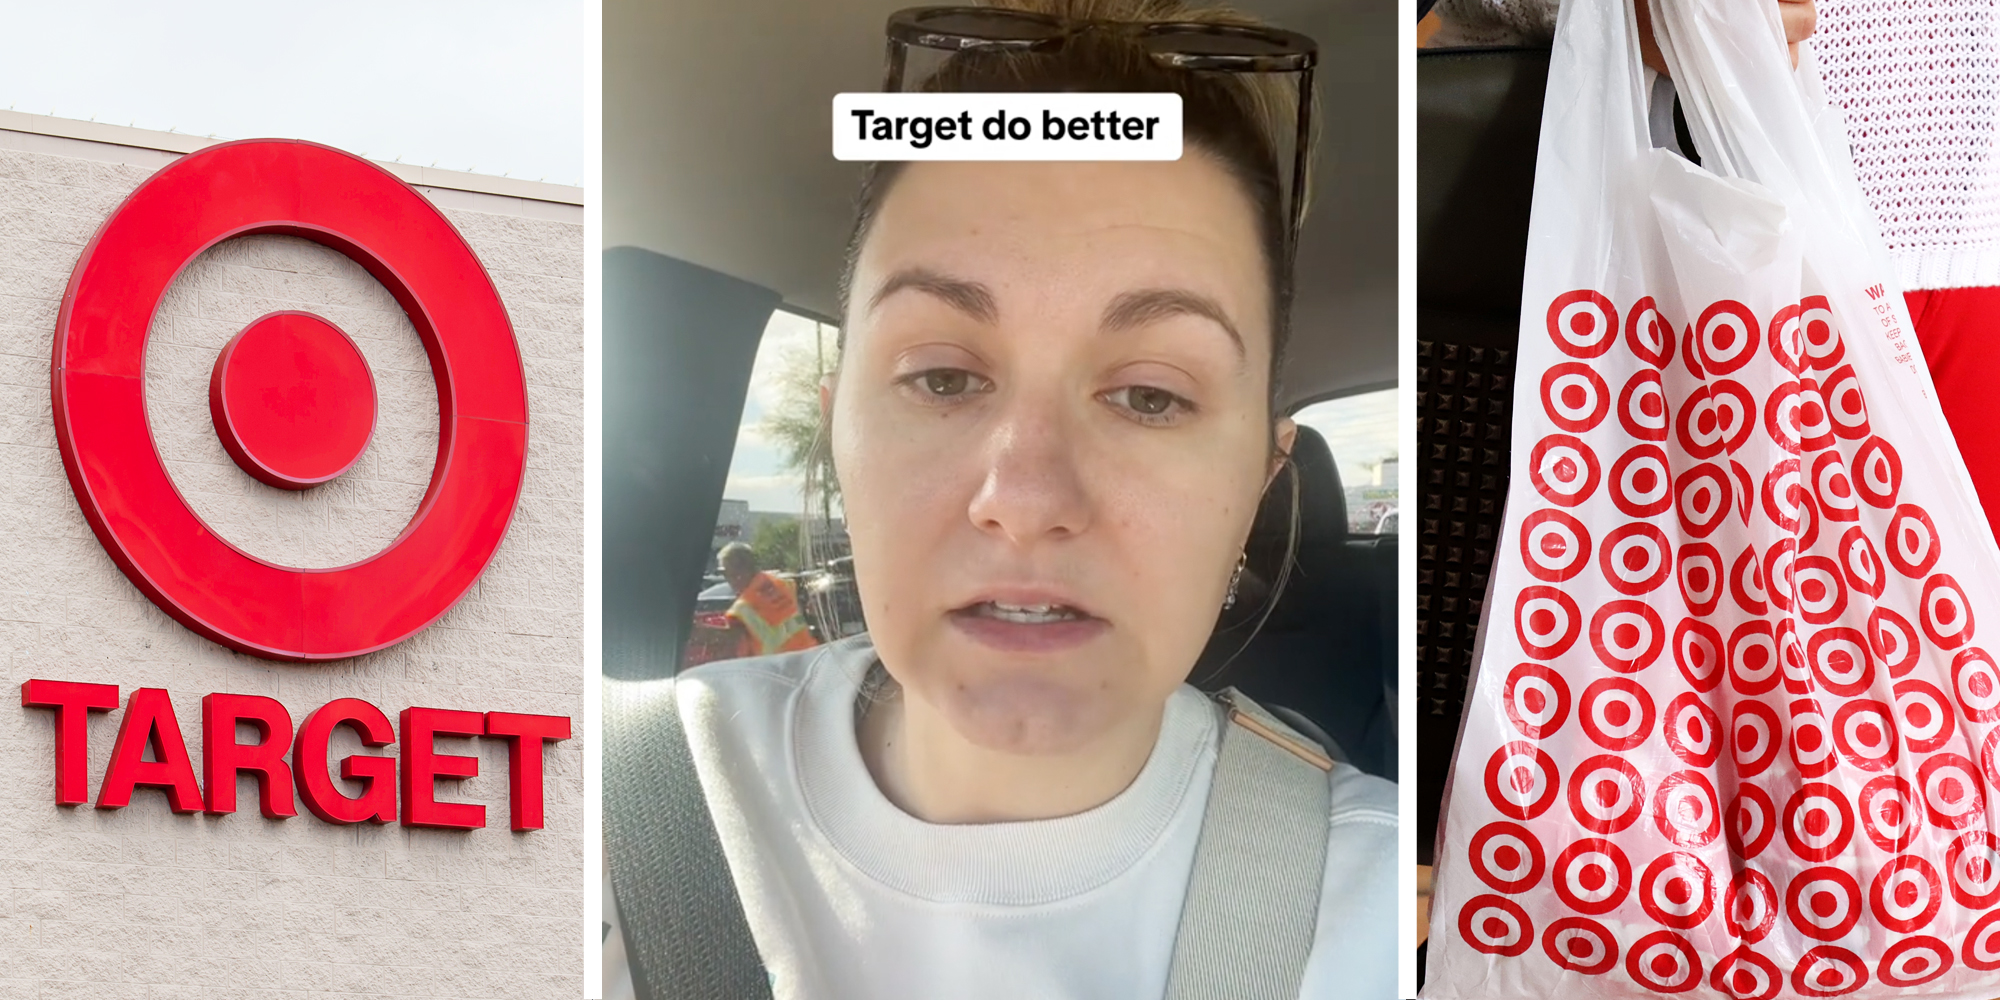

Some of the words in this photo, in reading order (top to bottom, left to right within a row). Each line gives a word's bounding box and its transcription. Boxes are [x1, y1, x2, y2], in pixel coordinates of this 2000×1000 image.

[1873, 305, 1885, 315] TO
[1881, 316, 1891, 327] OF
[1885, 327, 1901, 340] KEEP
[22, 679, 571, 832] TARGET
